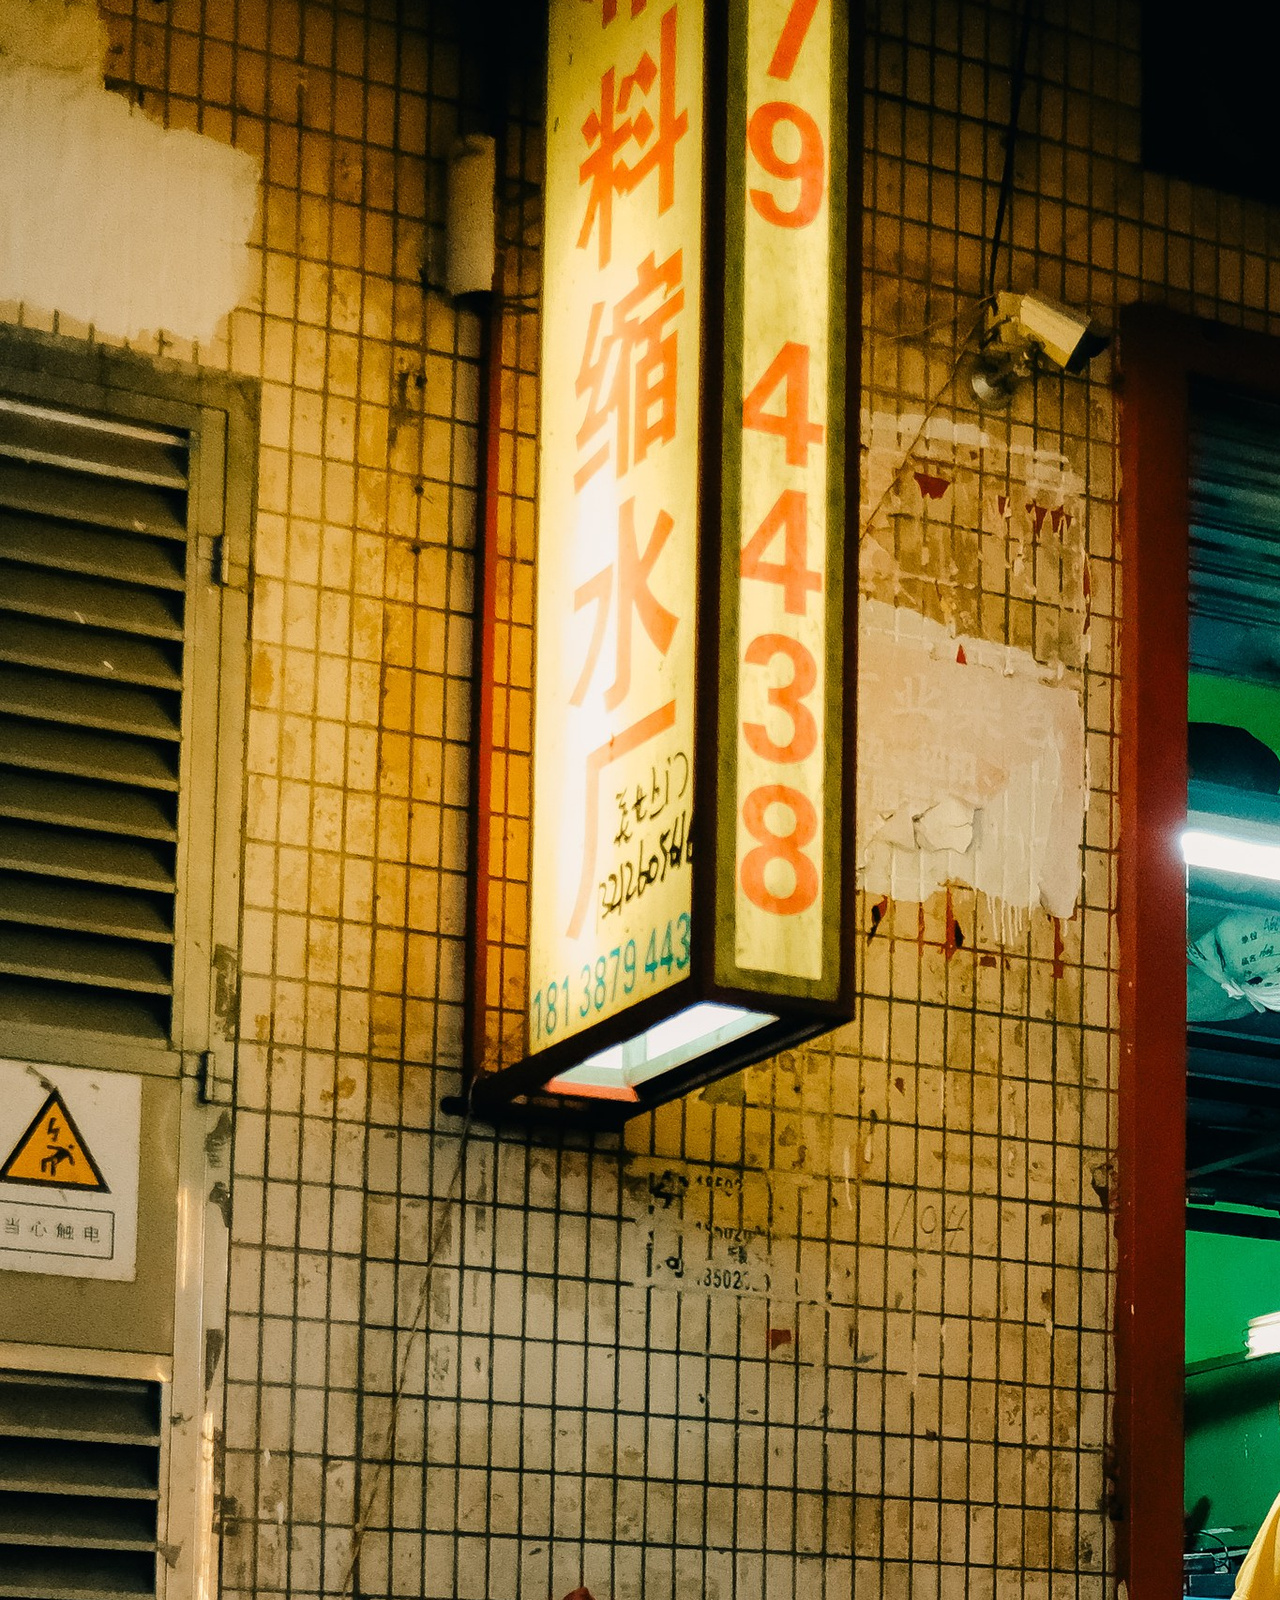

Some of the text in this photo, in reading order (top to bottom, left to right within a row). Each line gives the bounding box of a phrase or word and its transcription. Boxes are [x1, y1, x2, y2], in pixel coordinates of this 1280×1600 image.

[567, 0, 689, 940] 料缩水厂
[739, 341, 825, 917] 4438
[534, 911, 692, 1041] 181 3879 443
[3, 1216, 101, 1244] 当心触电
